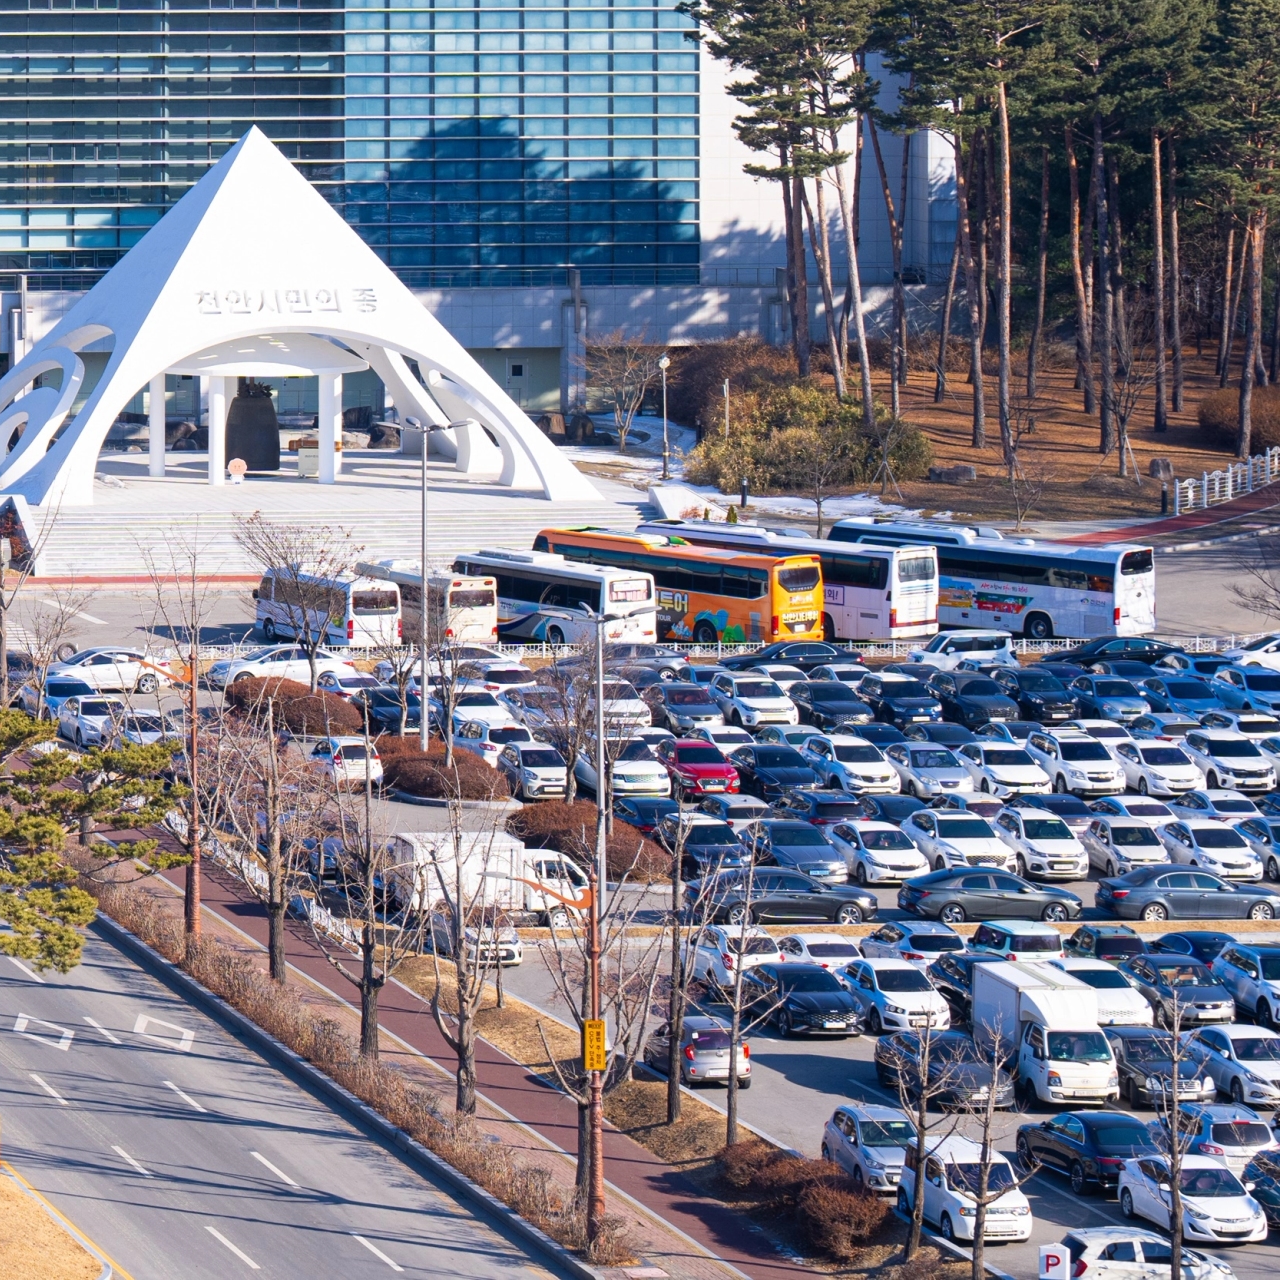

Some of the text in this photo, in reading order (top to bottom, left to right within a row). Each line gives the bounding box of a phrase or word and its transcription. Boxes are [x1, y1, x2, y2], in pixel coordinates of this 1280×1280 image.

[194, 288, 378, 314] 천안시민의 종
[657, 614, 672, 622] TOUR
[1045, 1254, 1061, 1273] P
